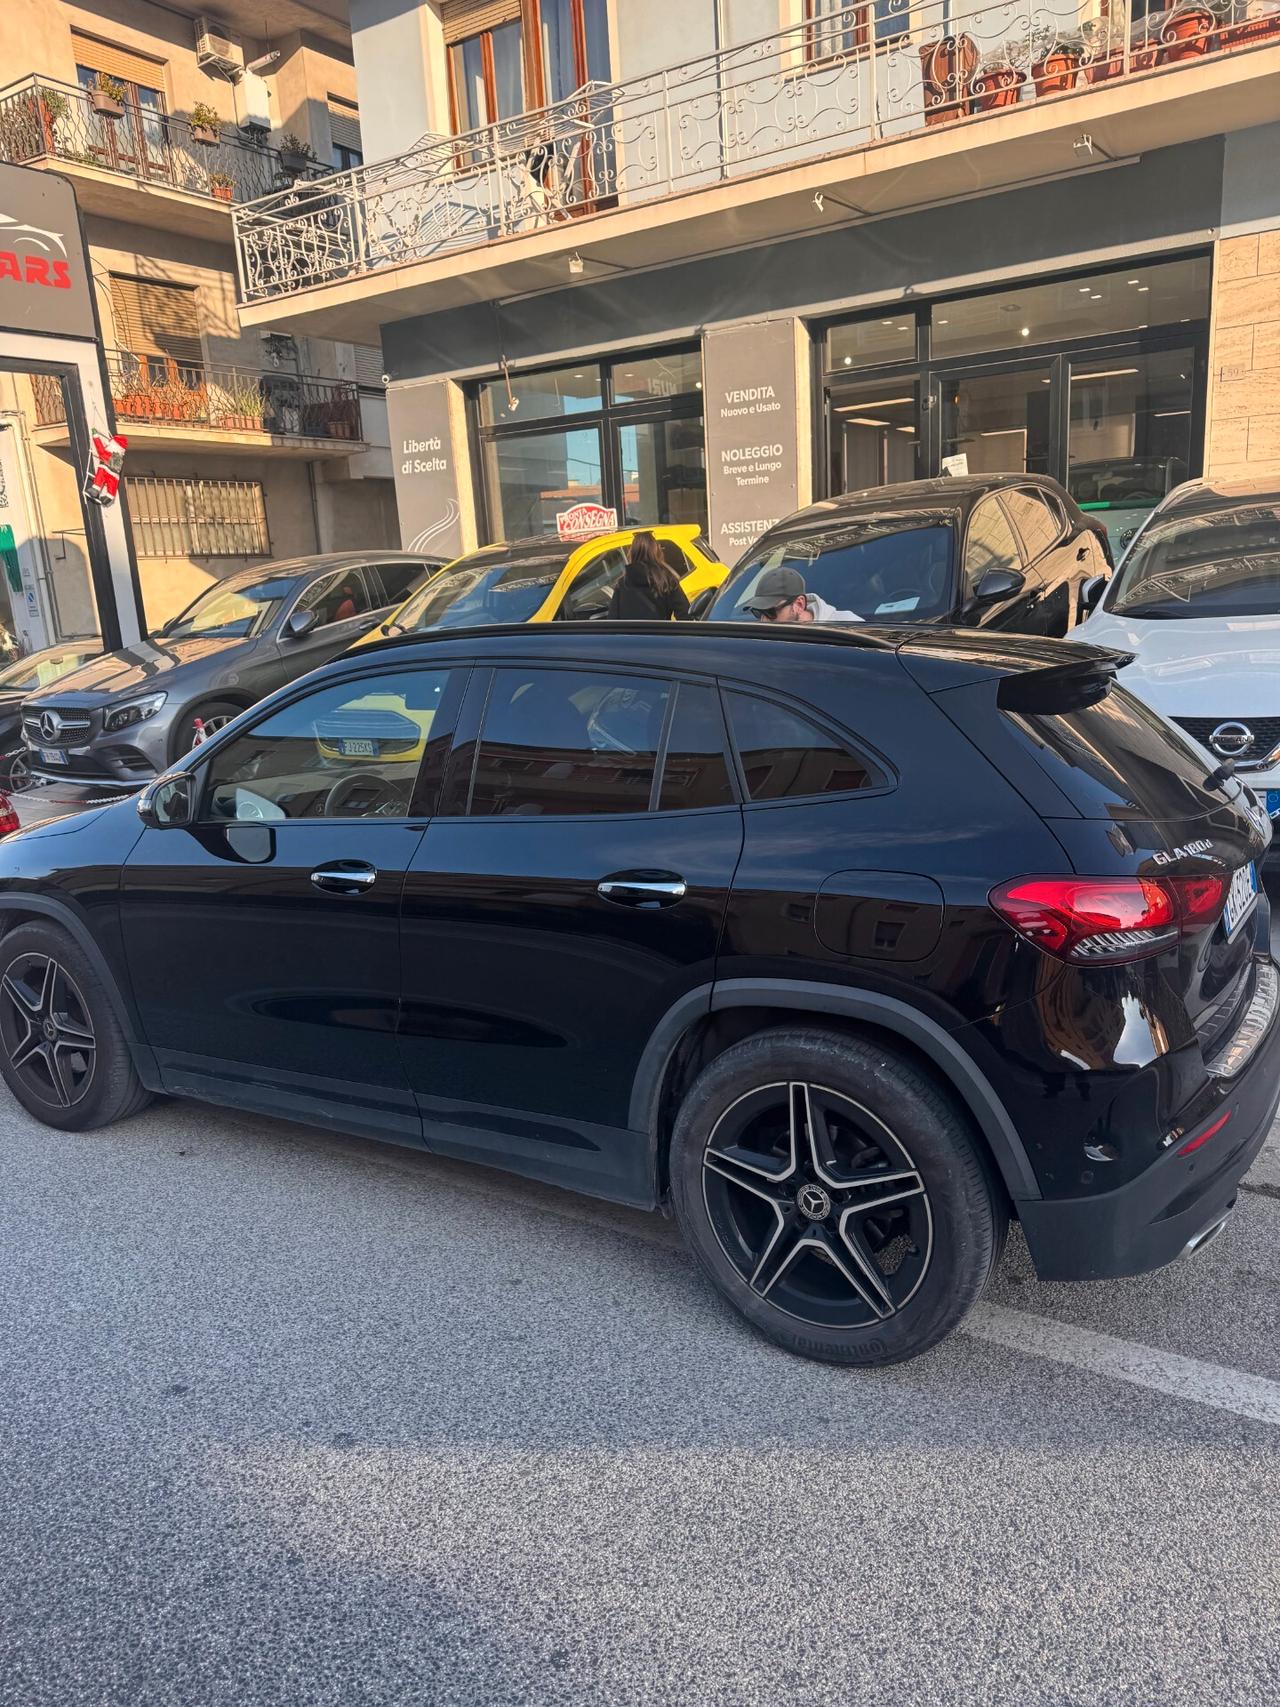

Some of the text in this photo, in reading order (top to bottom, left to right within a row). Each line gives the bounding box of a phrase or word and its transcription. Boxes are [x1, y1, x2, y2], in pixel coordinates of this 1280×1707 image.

[725, 386, 775, 404] VENDITA
[720, 402, 781, 418] Nuovo e Usato
[403, 436, 441, 454] Libertà
[721, 443, 783, 462] NOLEGGIO
[402, 457, 447, 474] di Scelta
[723, 461, 782, 475] Breve e Lungo
[736, 474, 769, 487] Termine
[564, 510, 615, 531] CONSEGNA
[729, 536, 747, 547] Post
